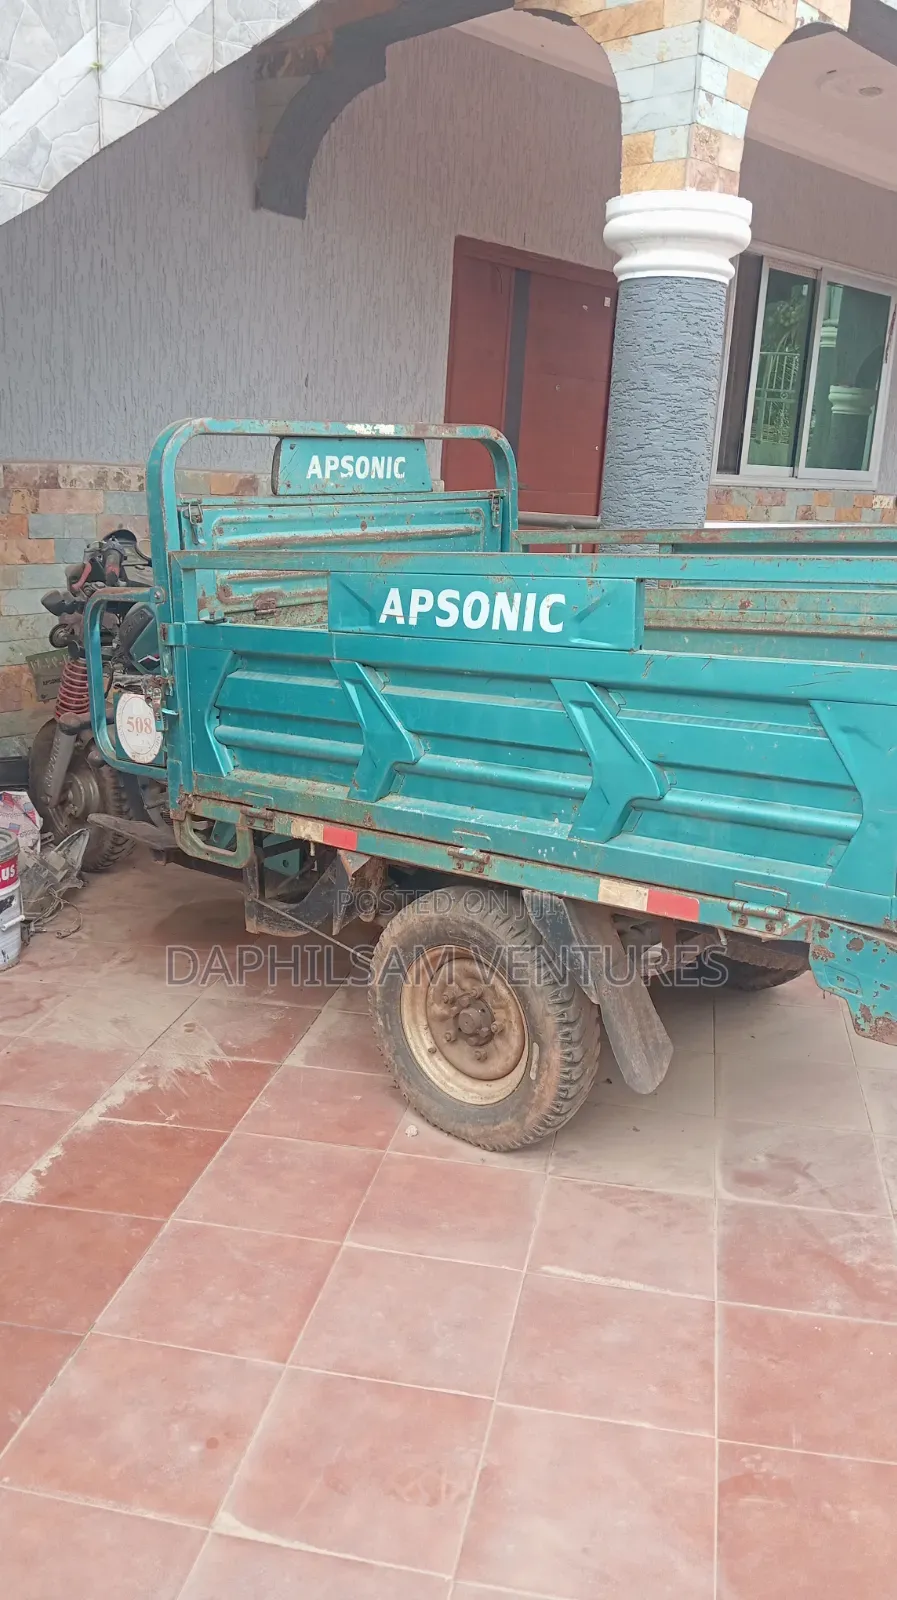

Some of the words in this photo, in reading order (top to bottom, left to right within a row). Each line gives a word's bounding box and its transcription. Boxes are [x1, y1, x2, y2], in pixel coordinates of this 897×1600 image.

[306, 455, 406, 480] APSONIC
[379, 587, 566, 633] APSONIC
[126, 715, 153, 735] 508
[0, 864, 16, 882] US
